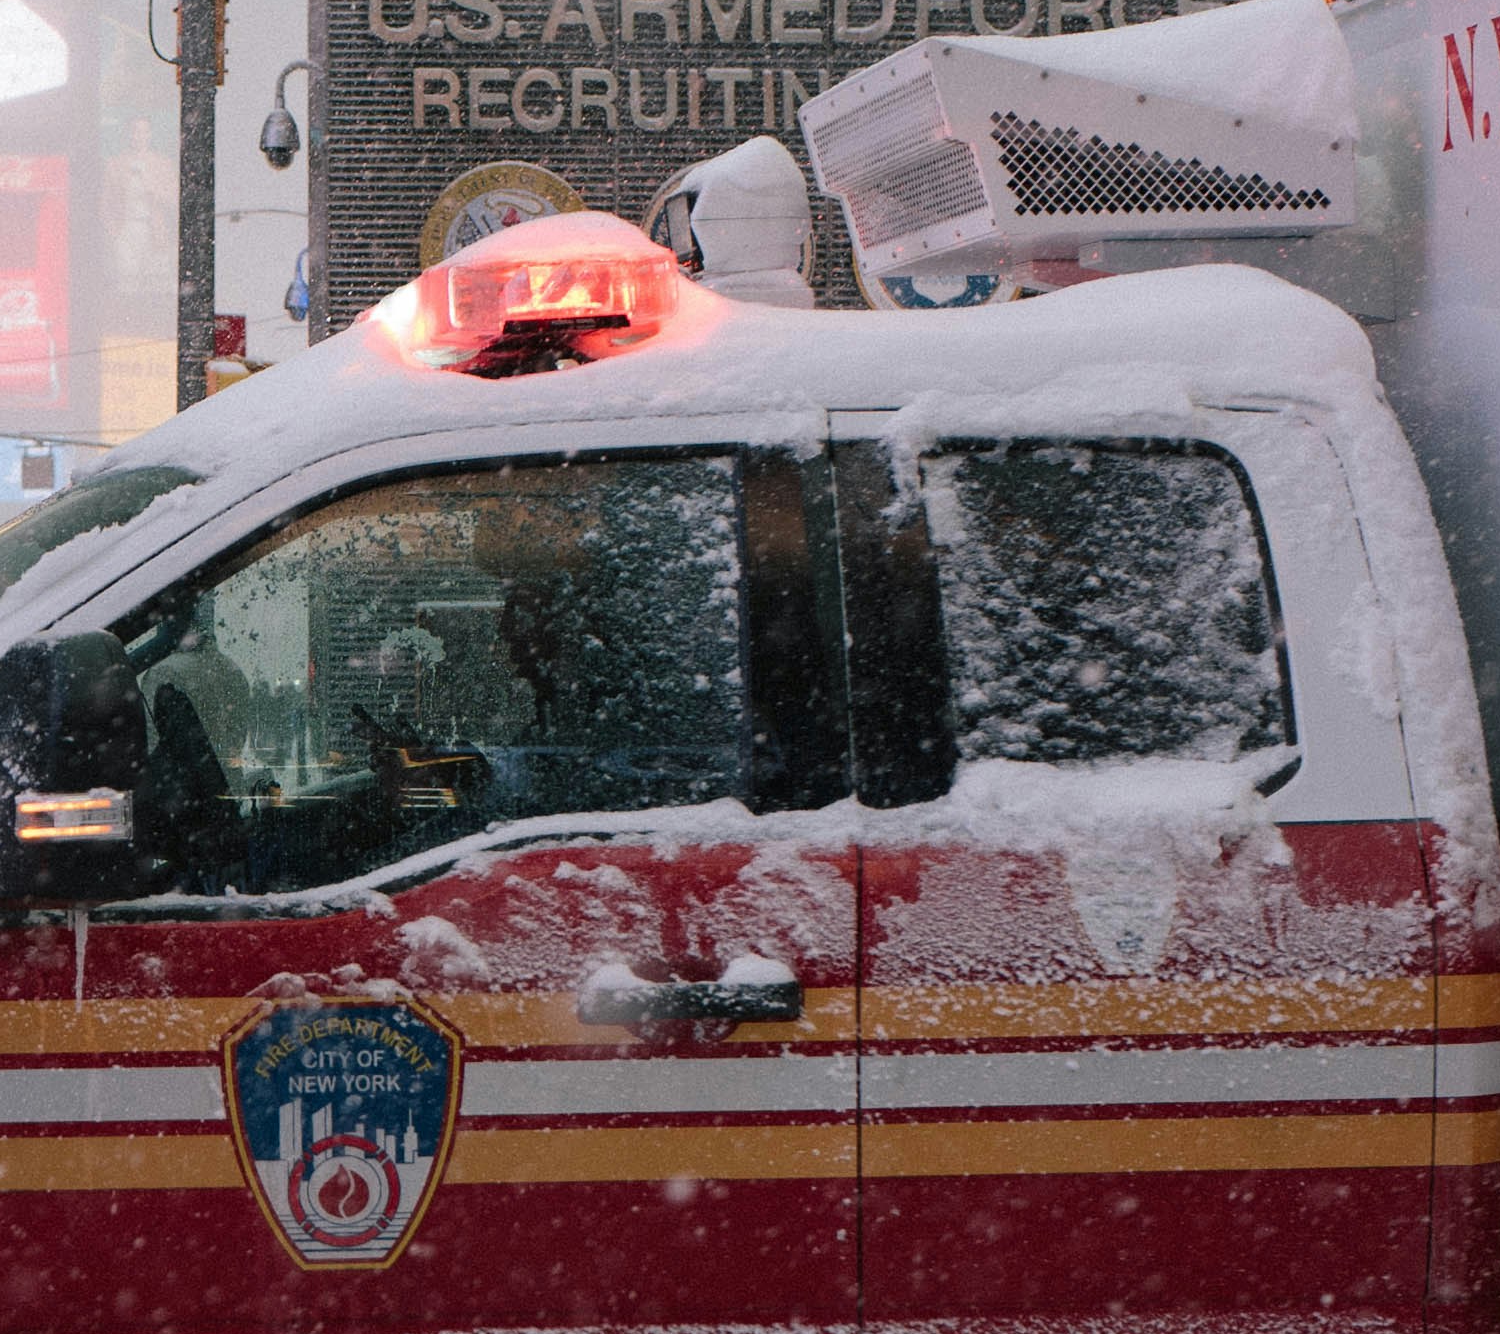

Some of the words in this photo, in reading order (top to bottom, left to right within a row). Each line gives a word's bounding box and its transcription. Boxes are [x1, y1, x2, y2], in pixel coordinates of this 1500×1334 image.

[413, 68, 829, 132] RECRUITIN
[254, 1032, 296, 1080] FIRE
[298, 1017, 435, 1074] DEPARTMENT
[304, 1050, 349, 1068] CITY
[357, 1050, 384, 1067] OF
[288, 1076, 336, 1094] NEW
[342, 1074, 401, 1093] YORK
